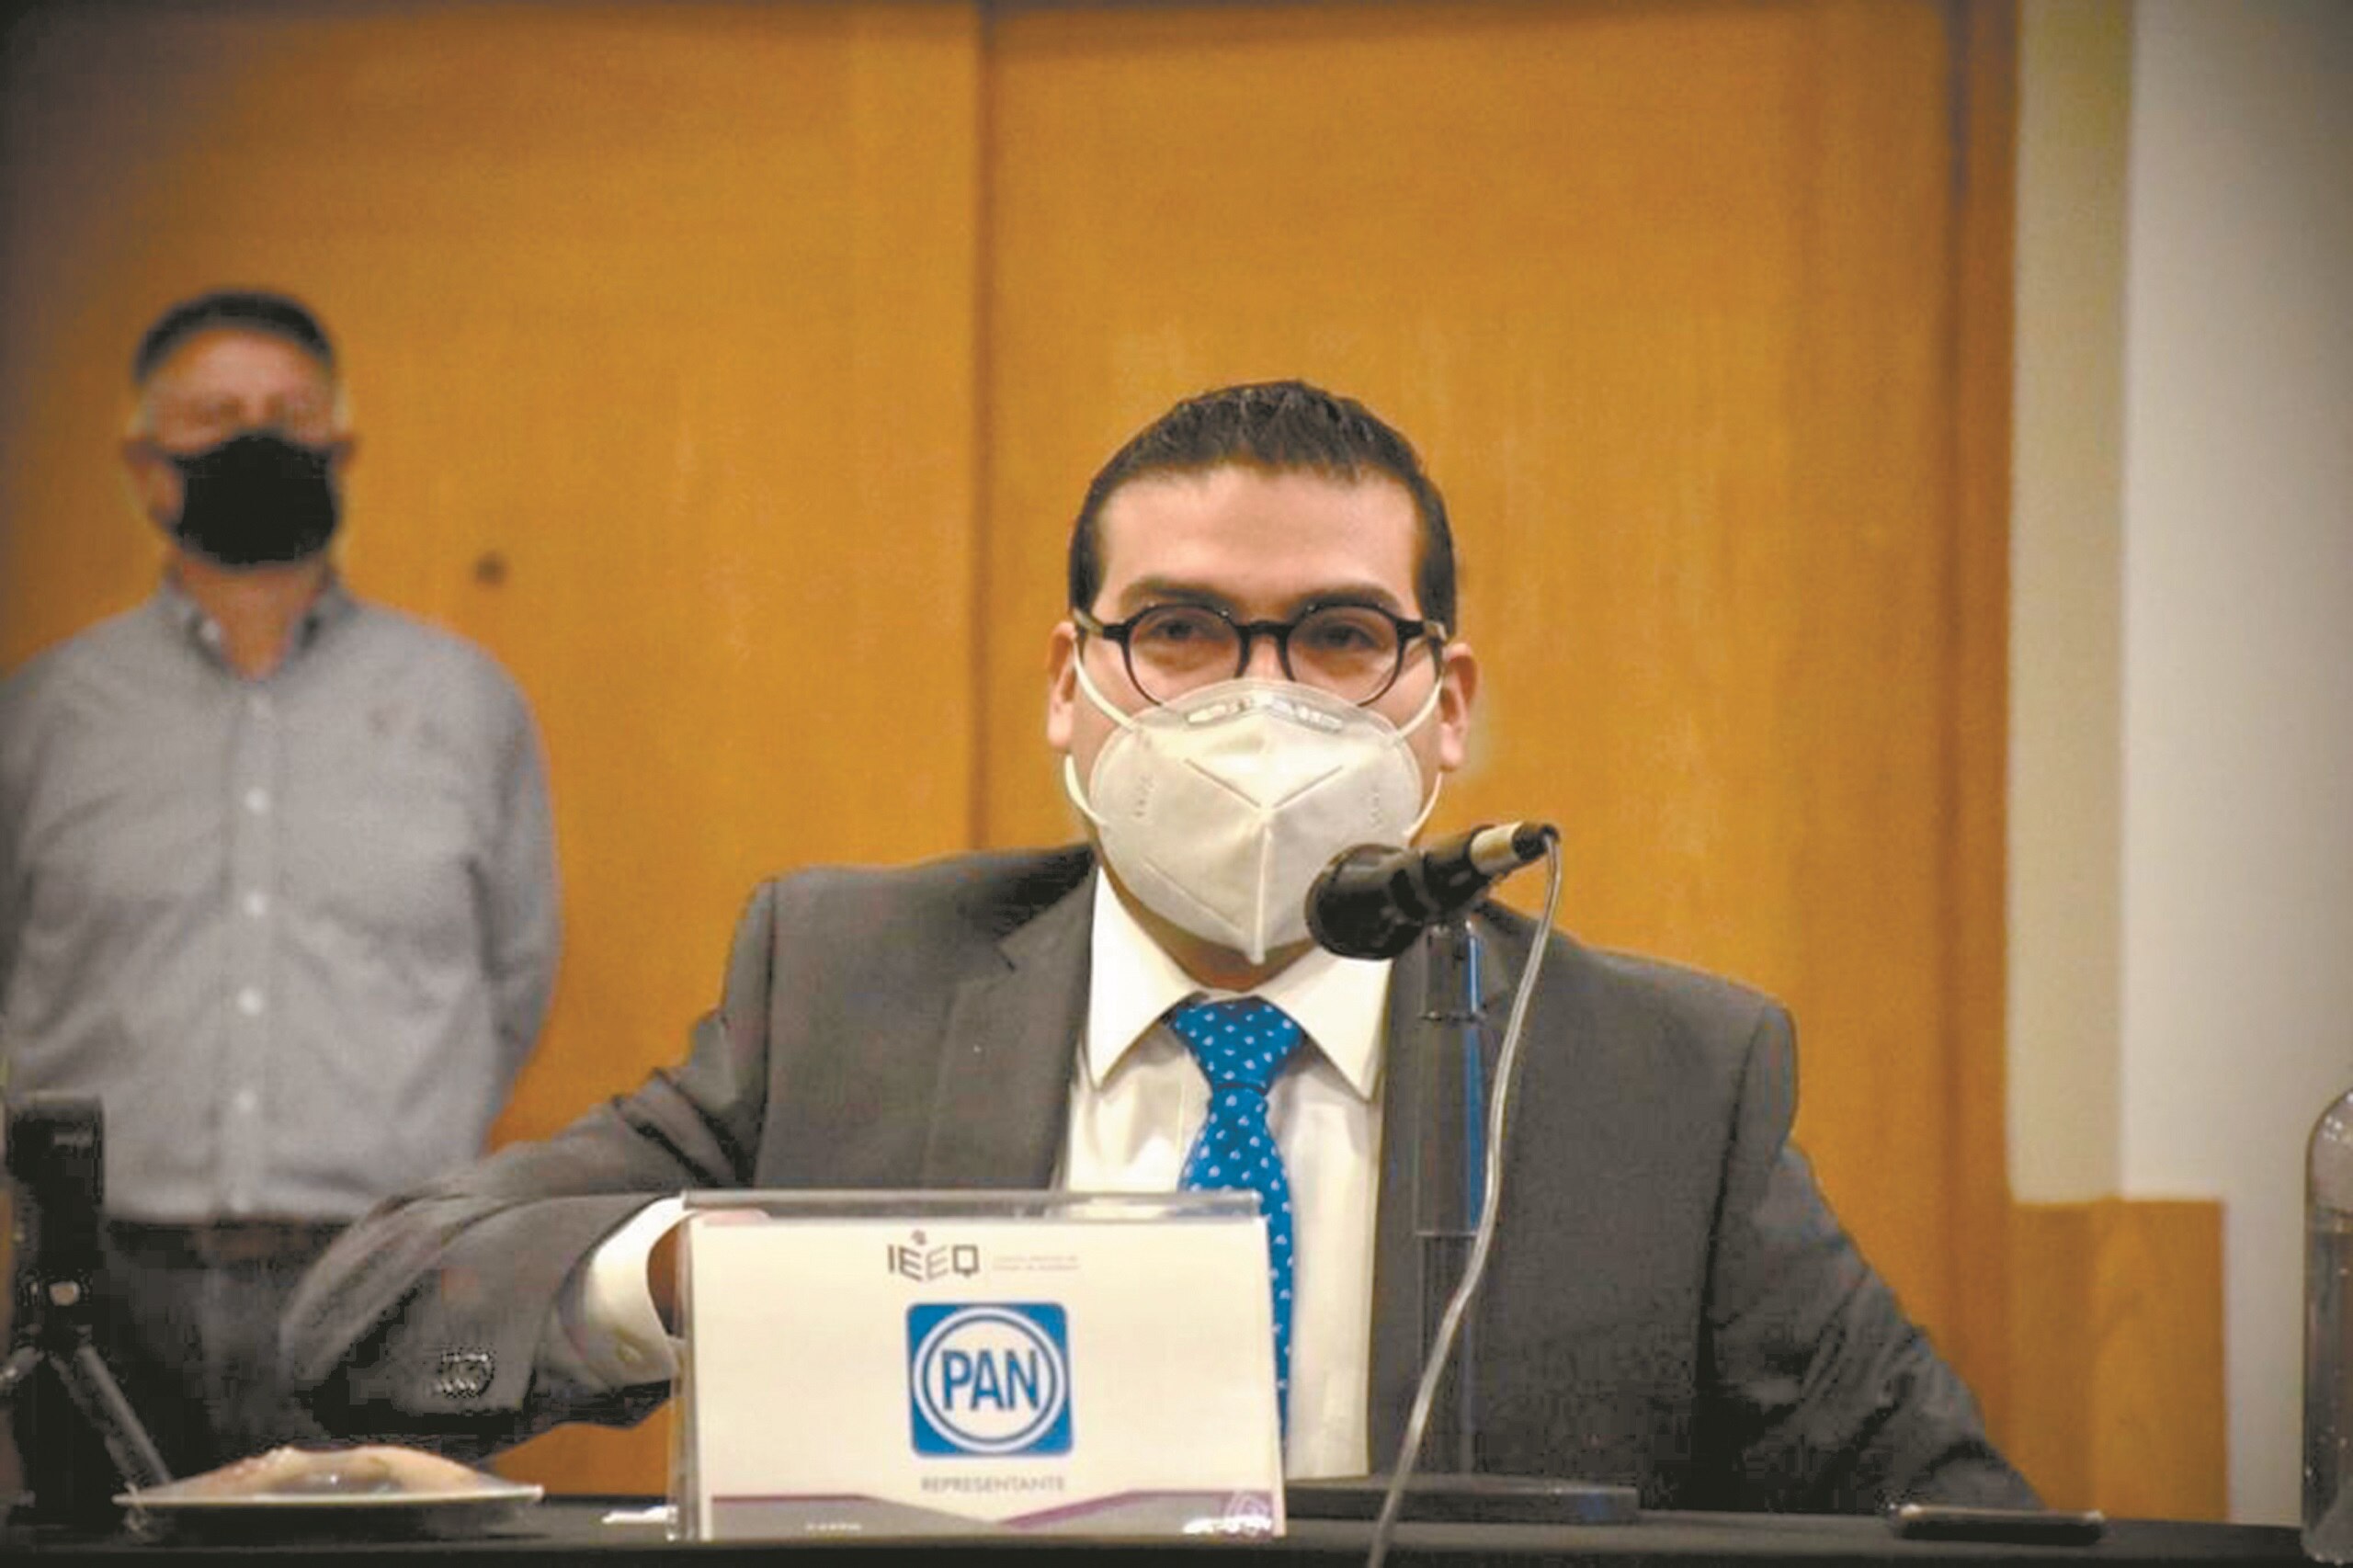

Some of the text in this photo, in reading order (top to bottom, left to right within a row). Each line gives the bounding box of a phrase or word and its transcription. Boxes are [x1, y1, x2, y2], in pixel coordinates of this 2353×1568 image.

[887, 1244, 980, 1281] IEEQ
[941, 1349, 1039, 1410] PAN
[921, 1476, 1065, 1492] REPRESENTANTE
